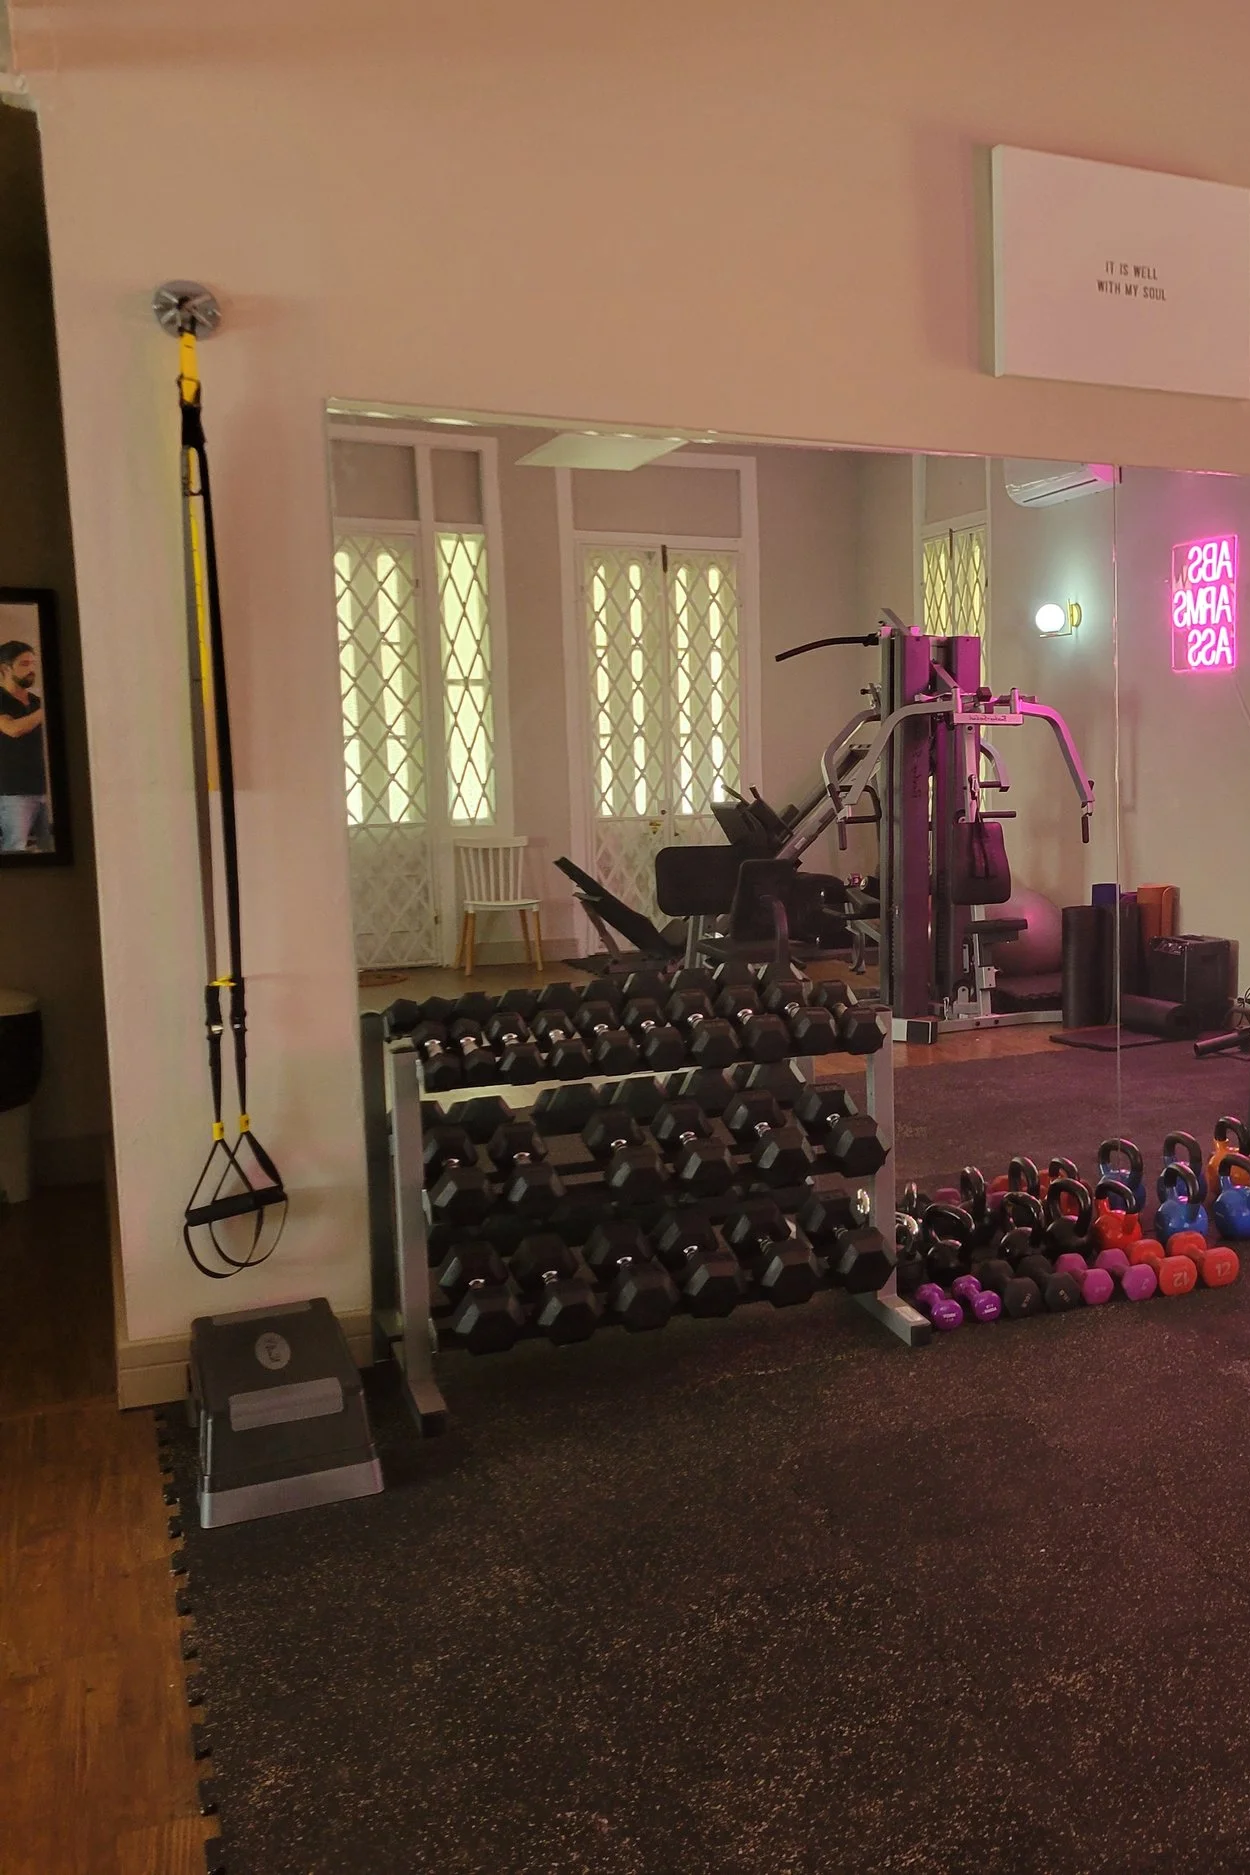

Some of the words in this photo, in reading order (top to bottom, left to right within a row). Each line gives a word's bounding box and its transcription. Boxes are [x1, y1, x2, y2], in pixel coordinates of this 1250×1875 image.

[1105, 260, 1115, 275] IT
[1120, 262, 1129, 276] IS
[1133, 265, 1158, 281] WELL
[1097, 279, 1121, 296] WITH
[1125, 282, 1139, 298] MY
[1143, 286, 1167, 302] SOUL
